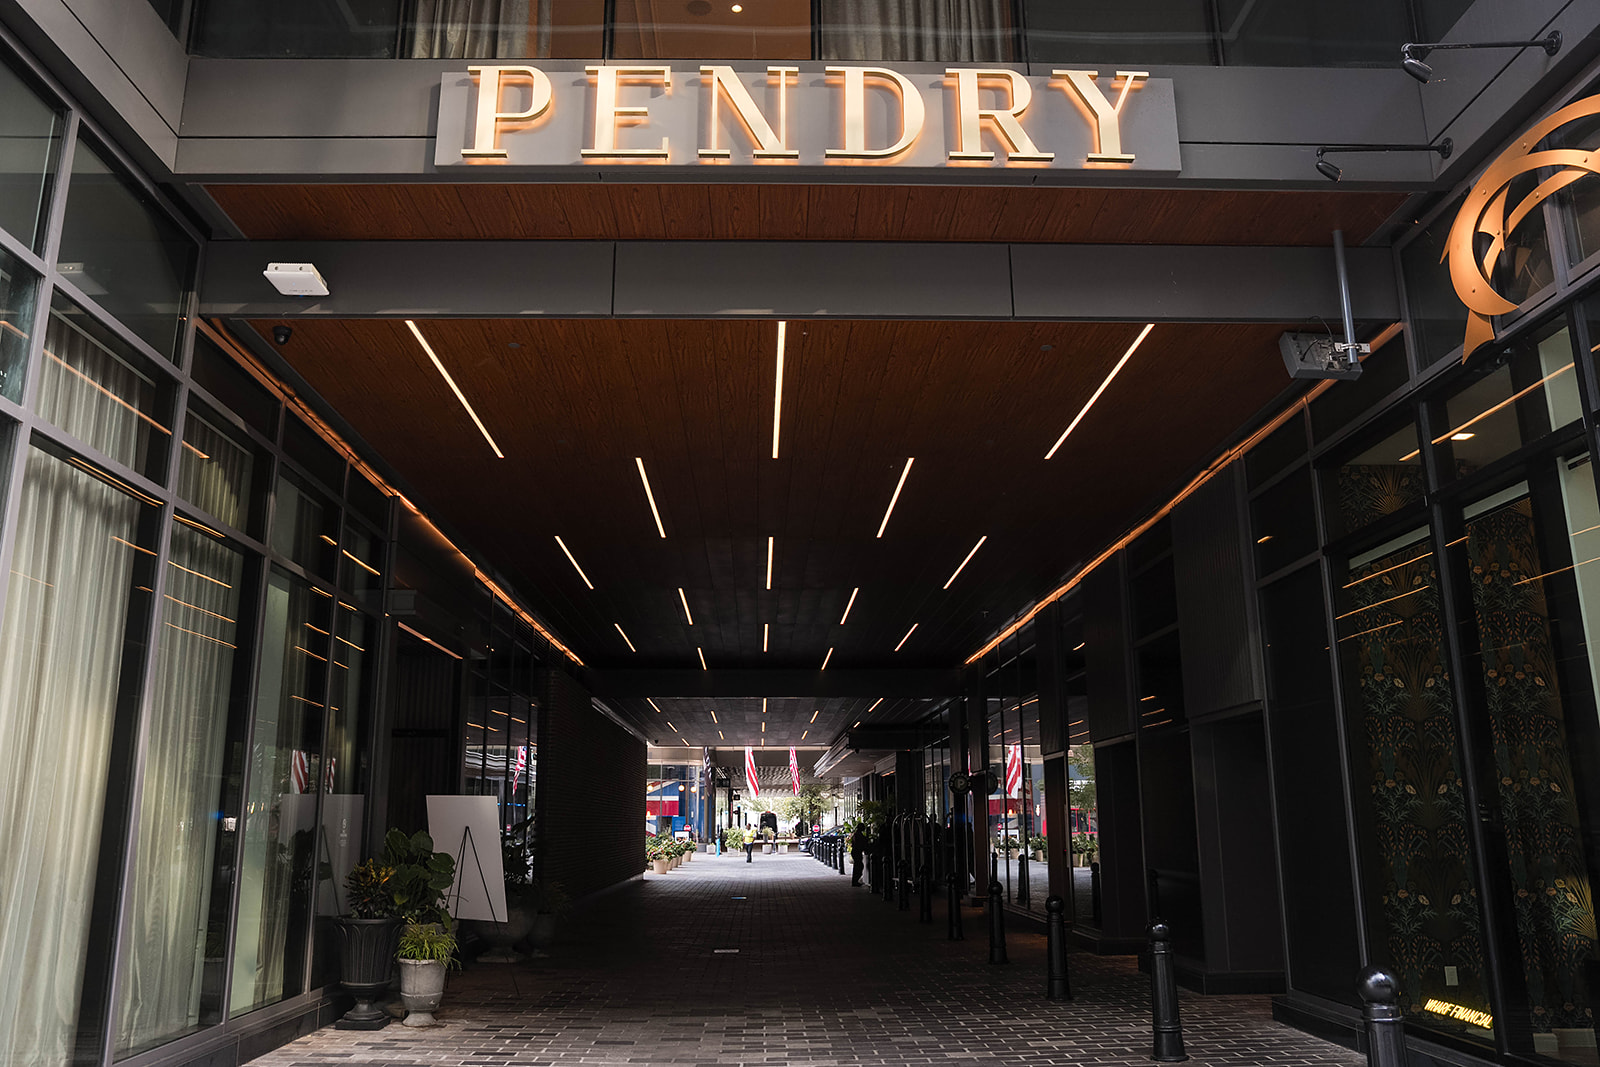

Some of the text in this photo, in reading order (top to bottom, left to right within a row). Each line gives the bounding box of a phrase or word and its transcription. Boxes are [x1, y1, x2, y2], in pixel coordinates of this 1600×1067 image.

[460, 65, 1149, 163] PENDRY
[1424, 999, 1493, 1029] WHARF FINANCIAL
